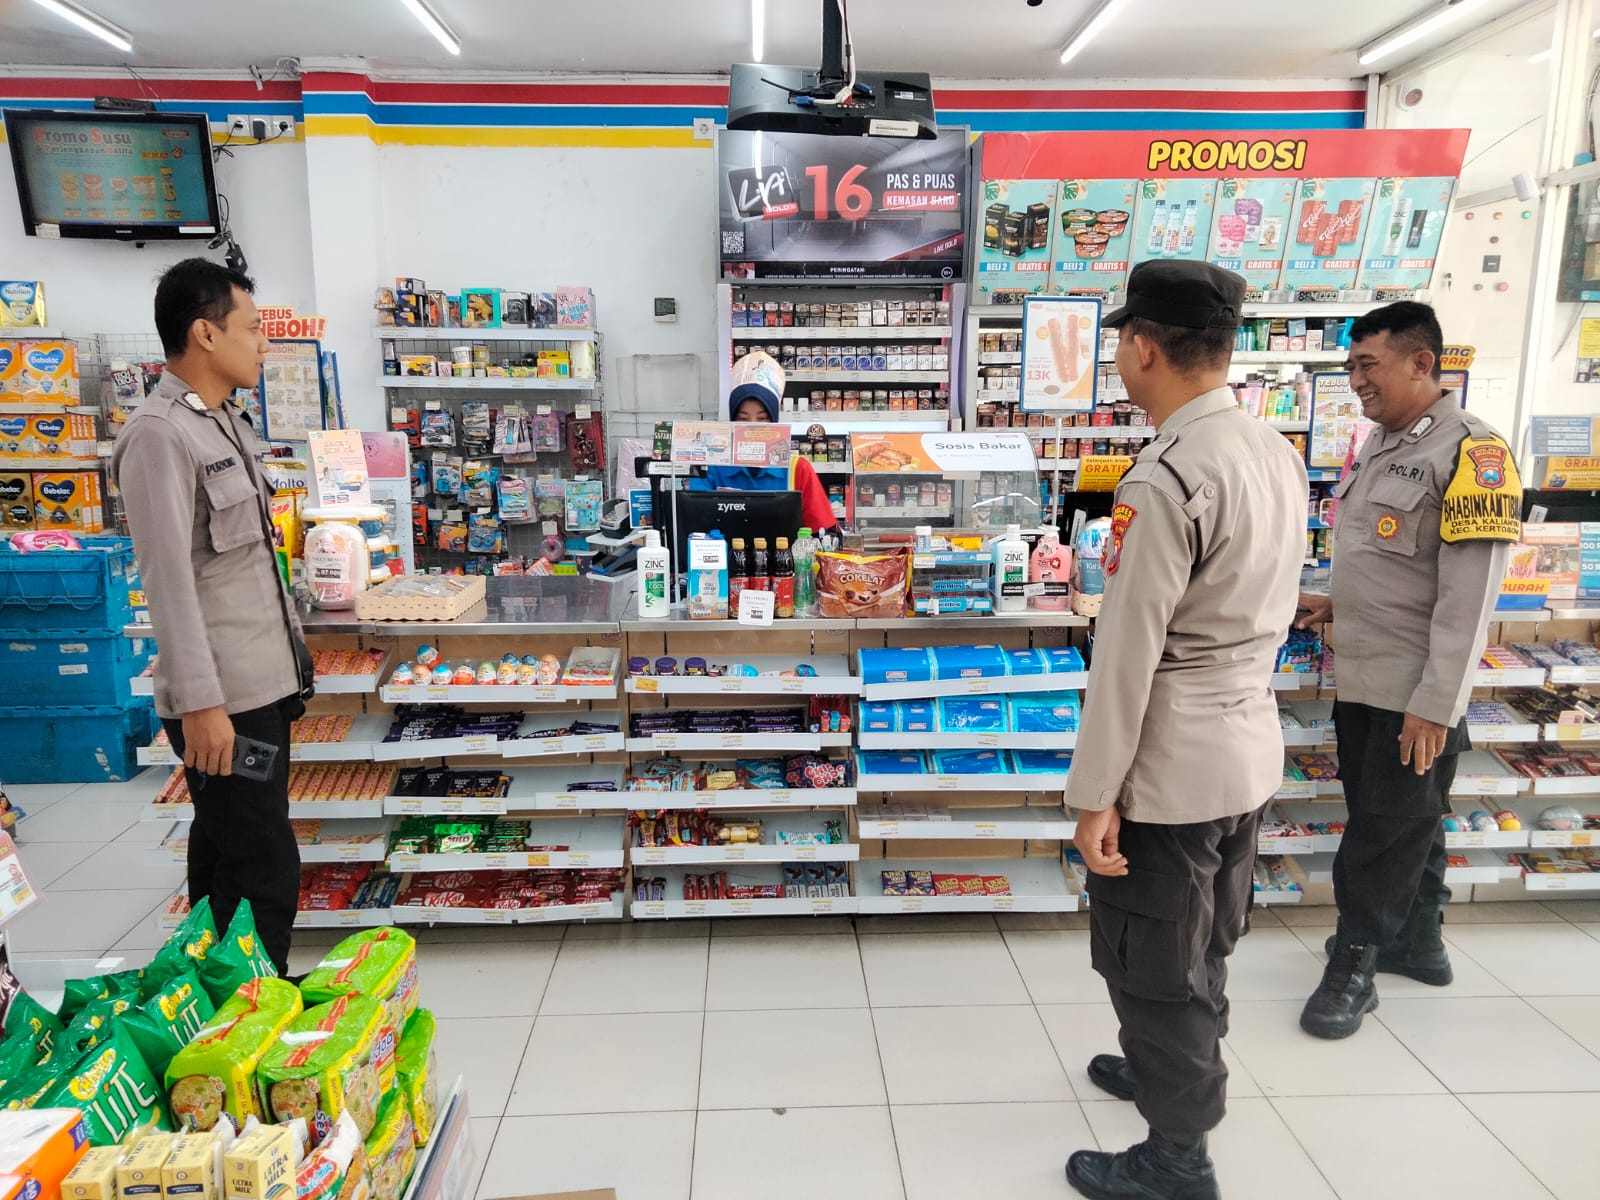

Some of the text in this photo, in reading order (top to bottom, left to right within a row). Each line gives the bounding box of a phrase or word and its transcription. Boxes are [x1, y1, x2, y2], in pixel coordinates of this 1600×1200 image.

[33, 127, 132, 145] Promo Susu
[1147, 139, 1308, 172] PROMOSI
[886, 173, 955, 190] PAS & PUAS
[805, 164, 873, 221] 16
[886, 195, 928, 206] KEMASAN
[986, 263, 1007, 271] BELI 2
[1017, 263, 1047, 271] GRATIS 1
[1062, 262, 1084, 271] BELI 2
[1093, 262, 1124, 271] GRATIS 1
[1217, 260, 1240, 269] BELI 2
[1247, 260, 1278, 270] GRATIS 1
[1294, 260, 1315, 269] BELI 2
[1324, 260, 1356, 269] GRATIS 1
[1371, 259, 1391, 269] BELI 1
[1401, 259, 1432, 269] GRATIS 1
[257, 309, 293, 321] TEBUS
[260, 319, 326, 338] HEBOH!
[1442, 347, 1471, 357] ING
[31, 355, 60, 364] Bebelac
[1440, 356, 1469, 367] RAH
[1027, 370, 1051, 381] 13K
[13, 378, 20, 388] 3
[61, 379, 68, 389] 4
[38, 423, 61, 431] Bebelac
[935, 442, 1023, 450] Sosis Bakar
[1085, 464, 1129, 473] GRATIS
[1387, 463, 1425, 482] POLRI
[43, 487, 71, 495] Bebelac
[717, 502, 747, 513] zyrex
[72, 508, 80, 519] 4
[1451, 519, 1479, 528] DESA
[1450, 526, 1473, 536] KEC.
[1004, 553, 1024, 562] ZINC
[645, 559, 665, 569] ZINC
[1086, 562, 1102, 570] Kah
[1582, 563, 1594, 571] 50
[839, 573, 887, 588] COKELAT
[424, 891, 465, 908] KitKat
[263, 1153, 289, 1180] ULTRA
[266, 1168, 287, 1186] MILK
[232, 1179, 253, 1187] ULTRA
[234, 1186, 252, 1194] MILK
